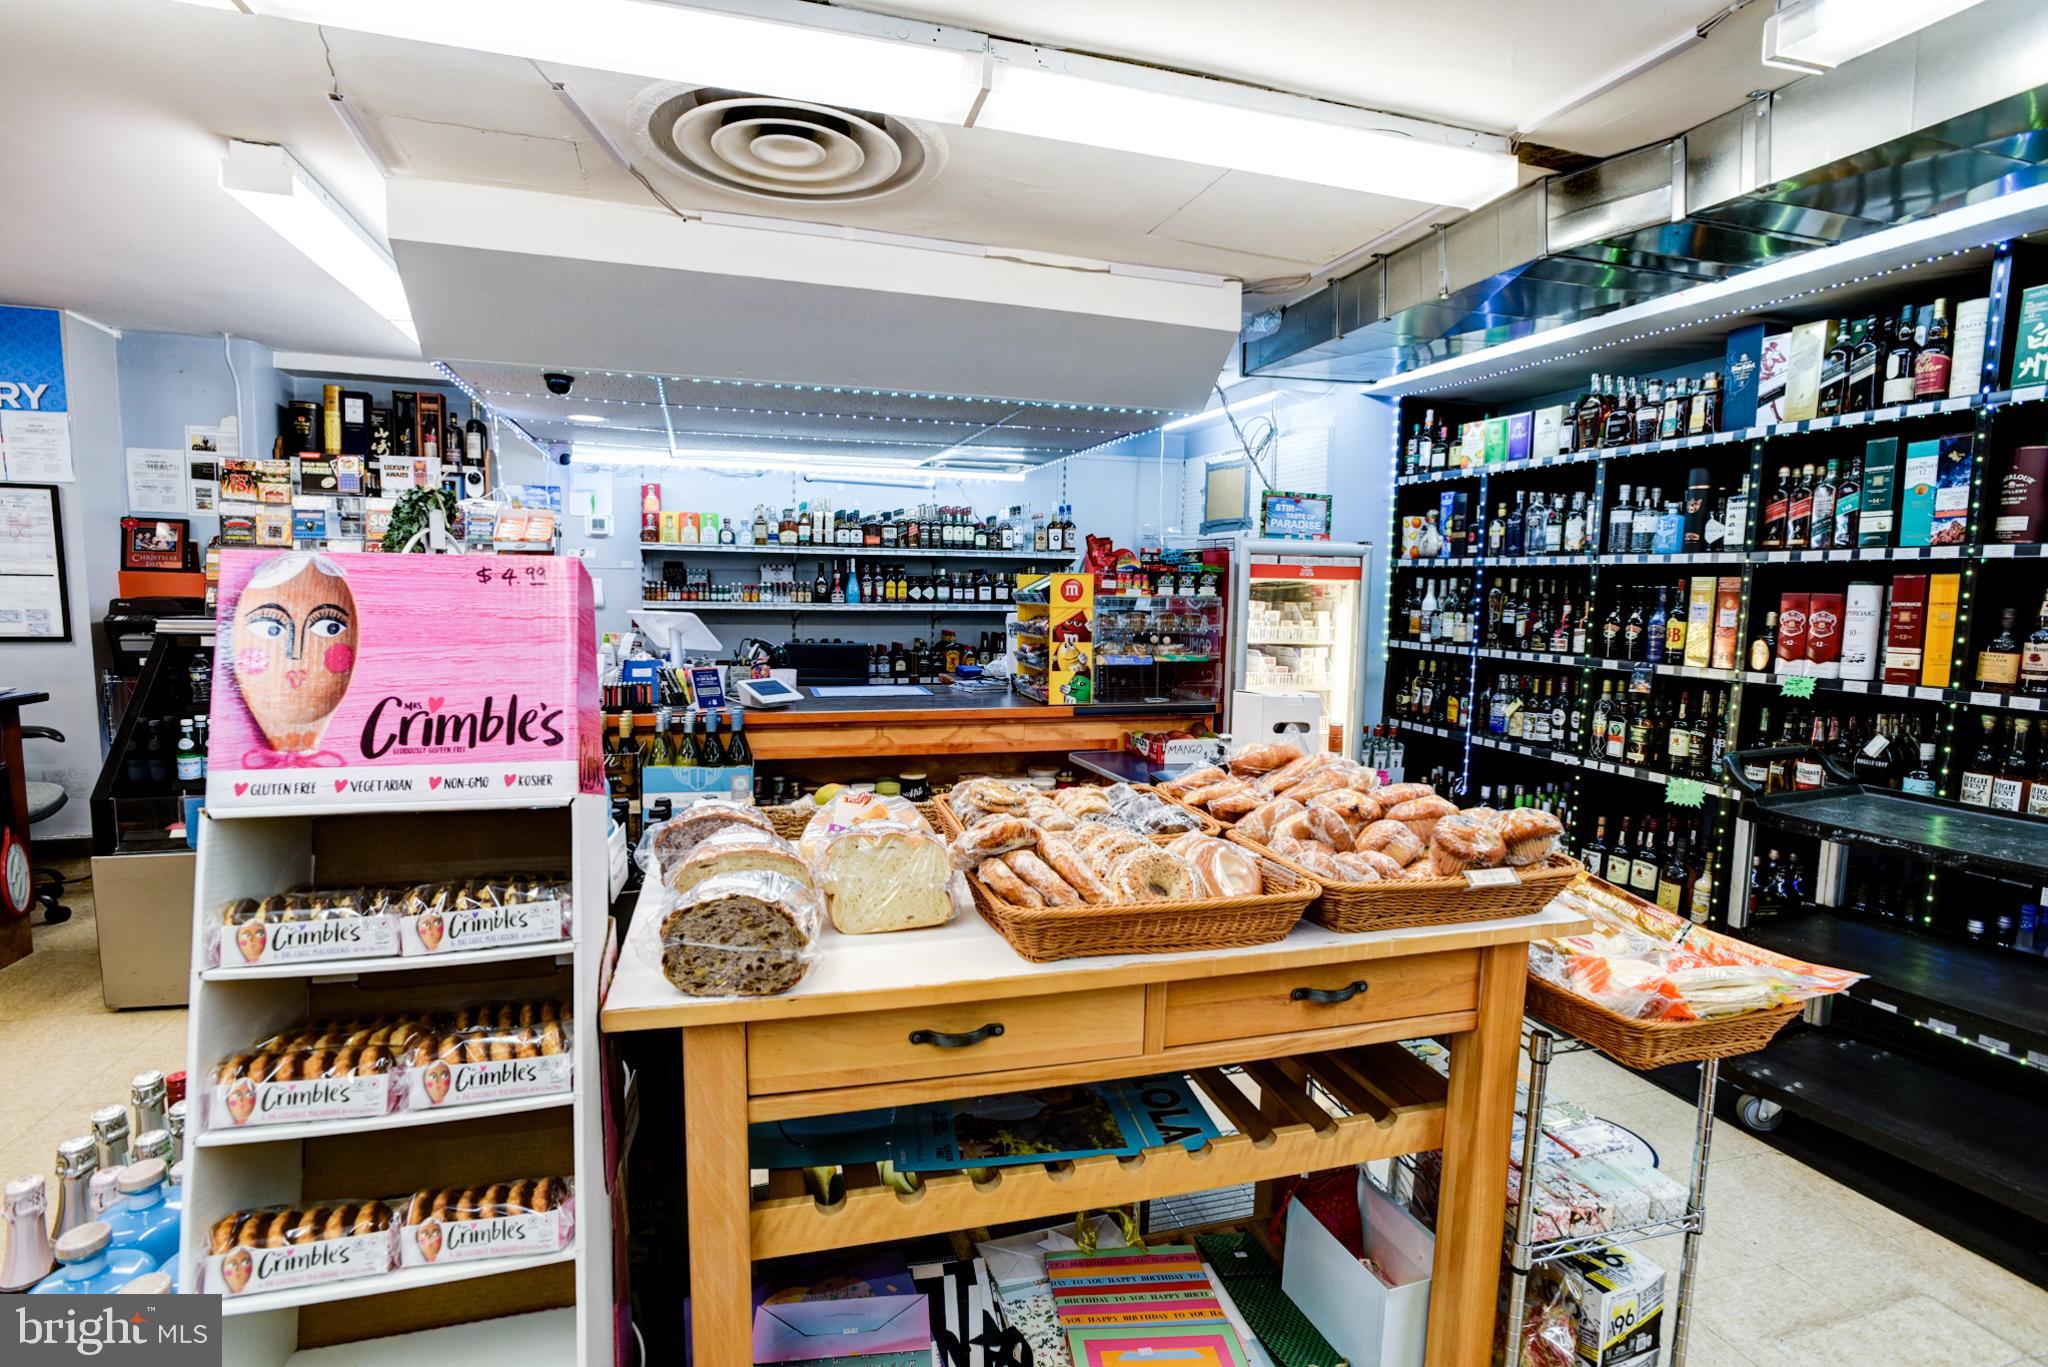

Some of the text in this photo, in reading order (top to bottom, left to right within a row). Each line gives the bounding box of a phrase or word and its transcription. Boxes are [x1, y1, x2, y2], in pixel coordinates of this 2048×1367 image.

[1275, 503, 1295, 512] STIR
[1270, 518, 1322, 530] PARADISE
[131, 553, 178, 562] CHRISTMAS
[360, 694, 564, 759] Crimble's
[428, 746, 451, 754] GLUTEN
[1167, 744, 1203, 755] MANGO
[350, 779, 412, 793] VEGETARIAN
[444, 776, 489, 789] NON-GMO
[518, 775, 552, 787] KOSHER
[1964, 775, 1988, 785] HIGH
[250, 782, 317, 796] GLUTEN FREE
[449, 908, 529, 939] Crimble's
[271, 922, 361, 951] Crimble's
[455, 1062, 537, 1092] Crimble's
[261, 1083, 350, 1112] Crimble's
[447, 1220, 526, 1250] Crimble's
[257, 1245, 350, 1279] Crimble's
[1070, 1259, 1111, 1268] BIRTHDAY
[1152, 1255, 1180, 1263] HAPPY
[1050, 1279, 1067, 1287] DAY
[1088, 1277, 1103, 1286] YOU
[1108, 1275, 1137, 1284] HAPPY
[1141, 1273, 1184, 1282] BIRTHDAY
[1064, 1296, 1110, 1305] BIRTHDAY
[1129, 1294, 1145, 1302] YOU
[1065, 1316, 1084, 1324] YOU
[1088, 1314, 1118, 1323] HAPPY
[1123, 1313, 1168, 1322] BIRTHDAY
